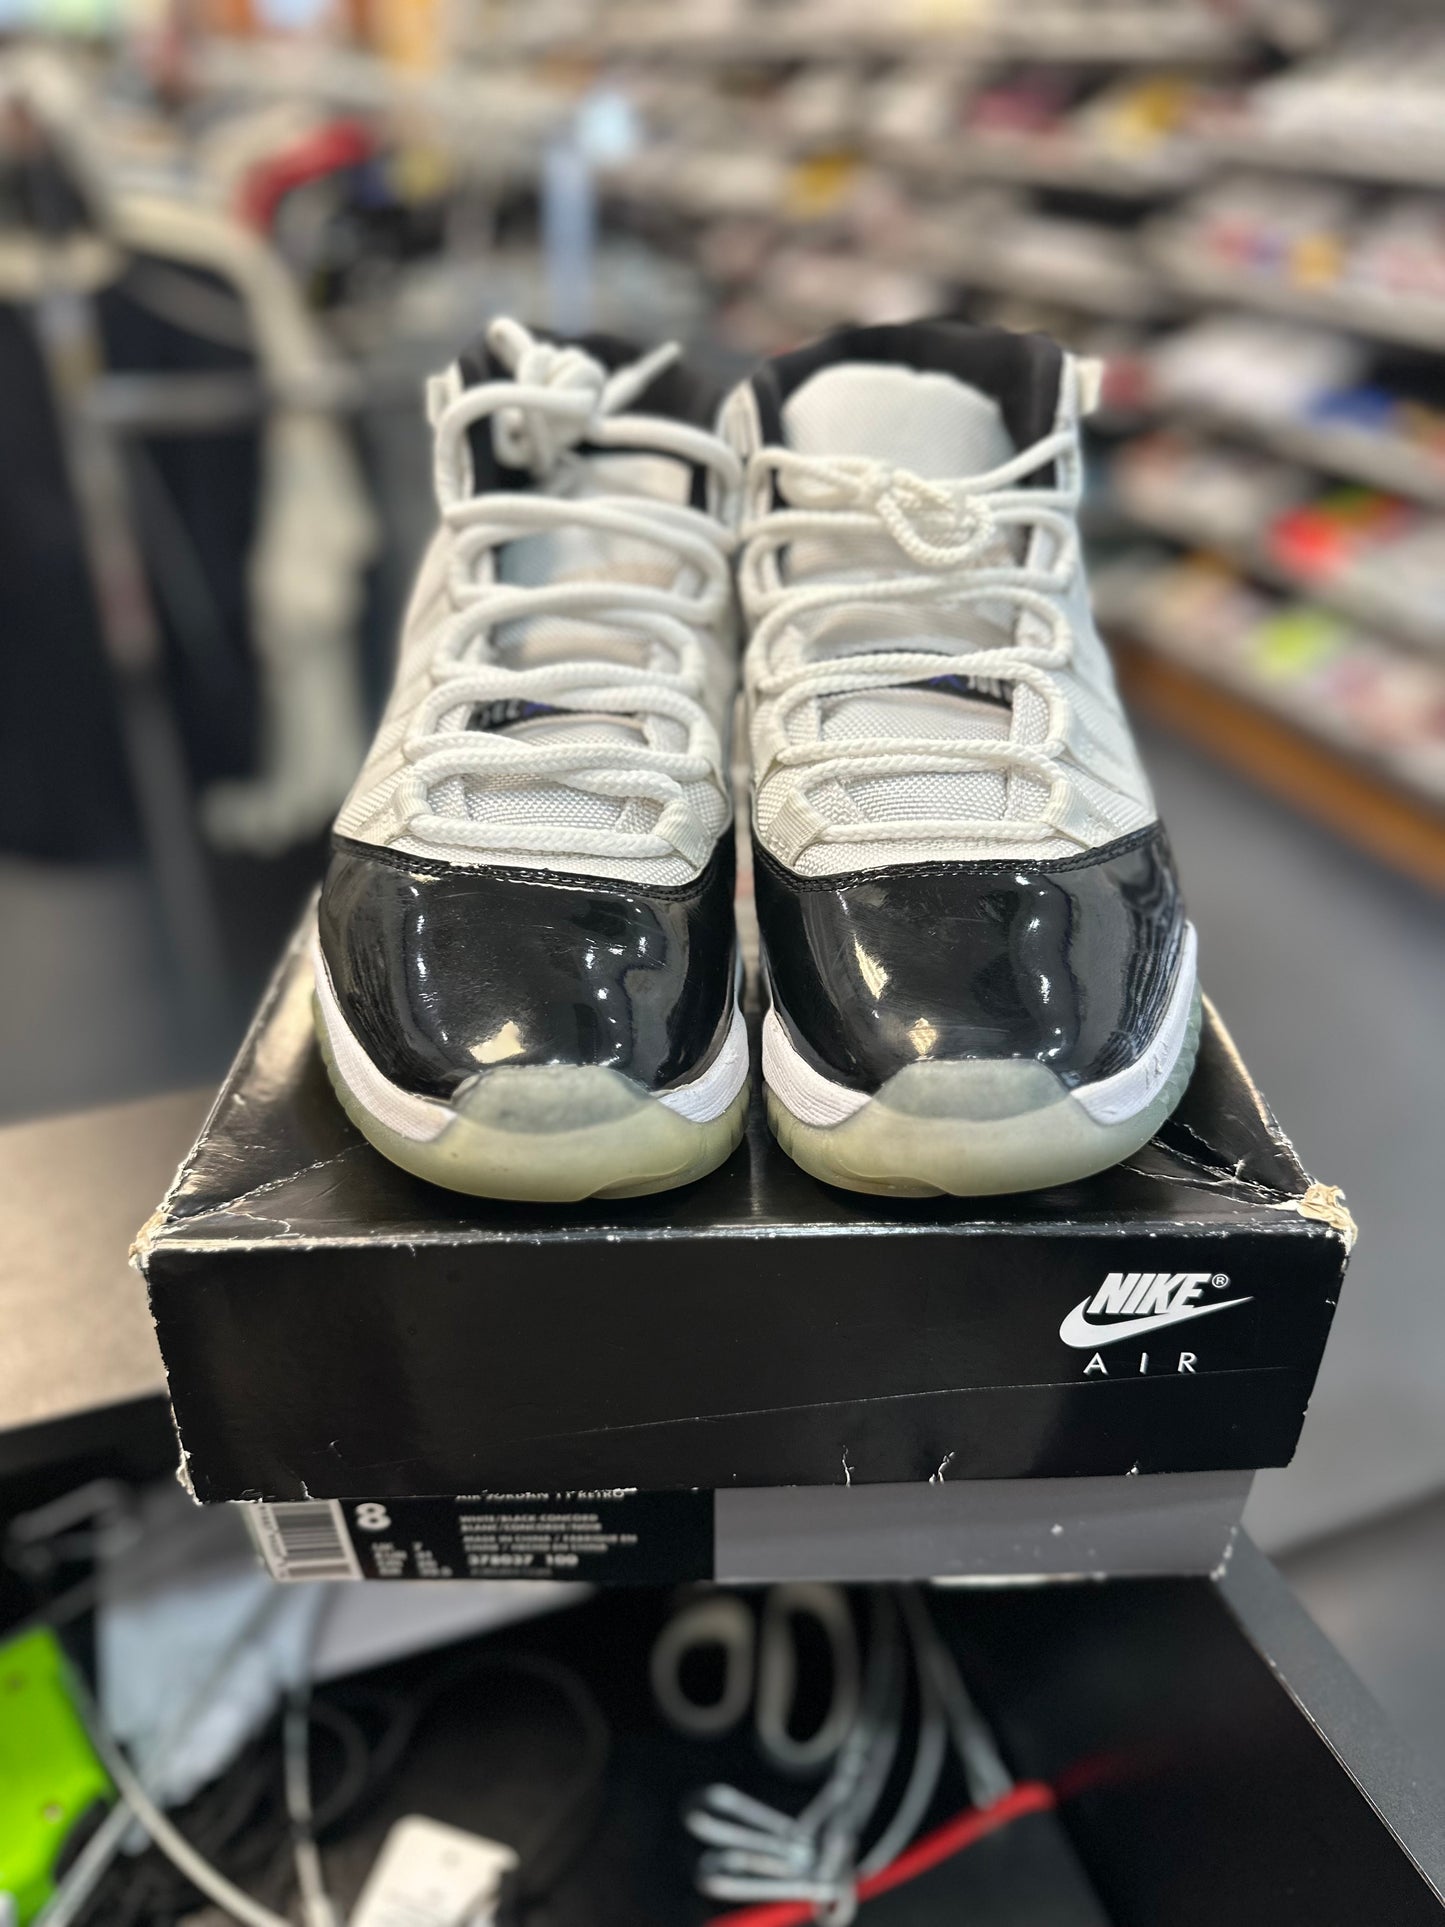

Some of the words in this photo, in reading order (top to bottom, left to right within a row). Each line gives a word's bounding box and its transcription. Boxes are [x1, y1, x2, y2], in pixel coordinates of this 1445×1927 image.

[1083, 1352, 1198, 1375] AIR
[355, 1502, 392, 1531] 8
[467, 1554, 534, 1567] 378037
[544, 1554, 579, 1567] 100
